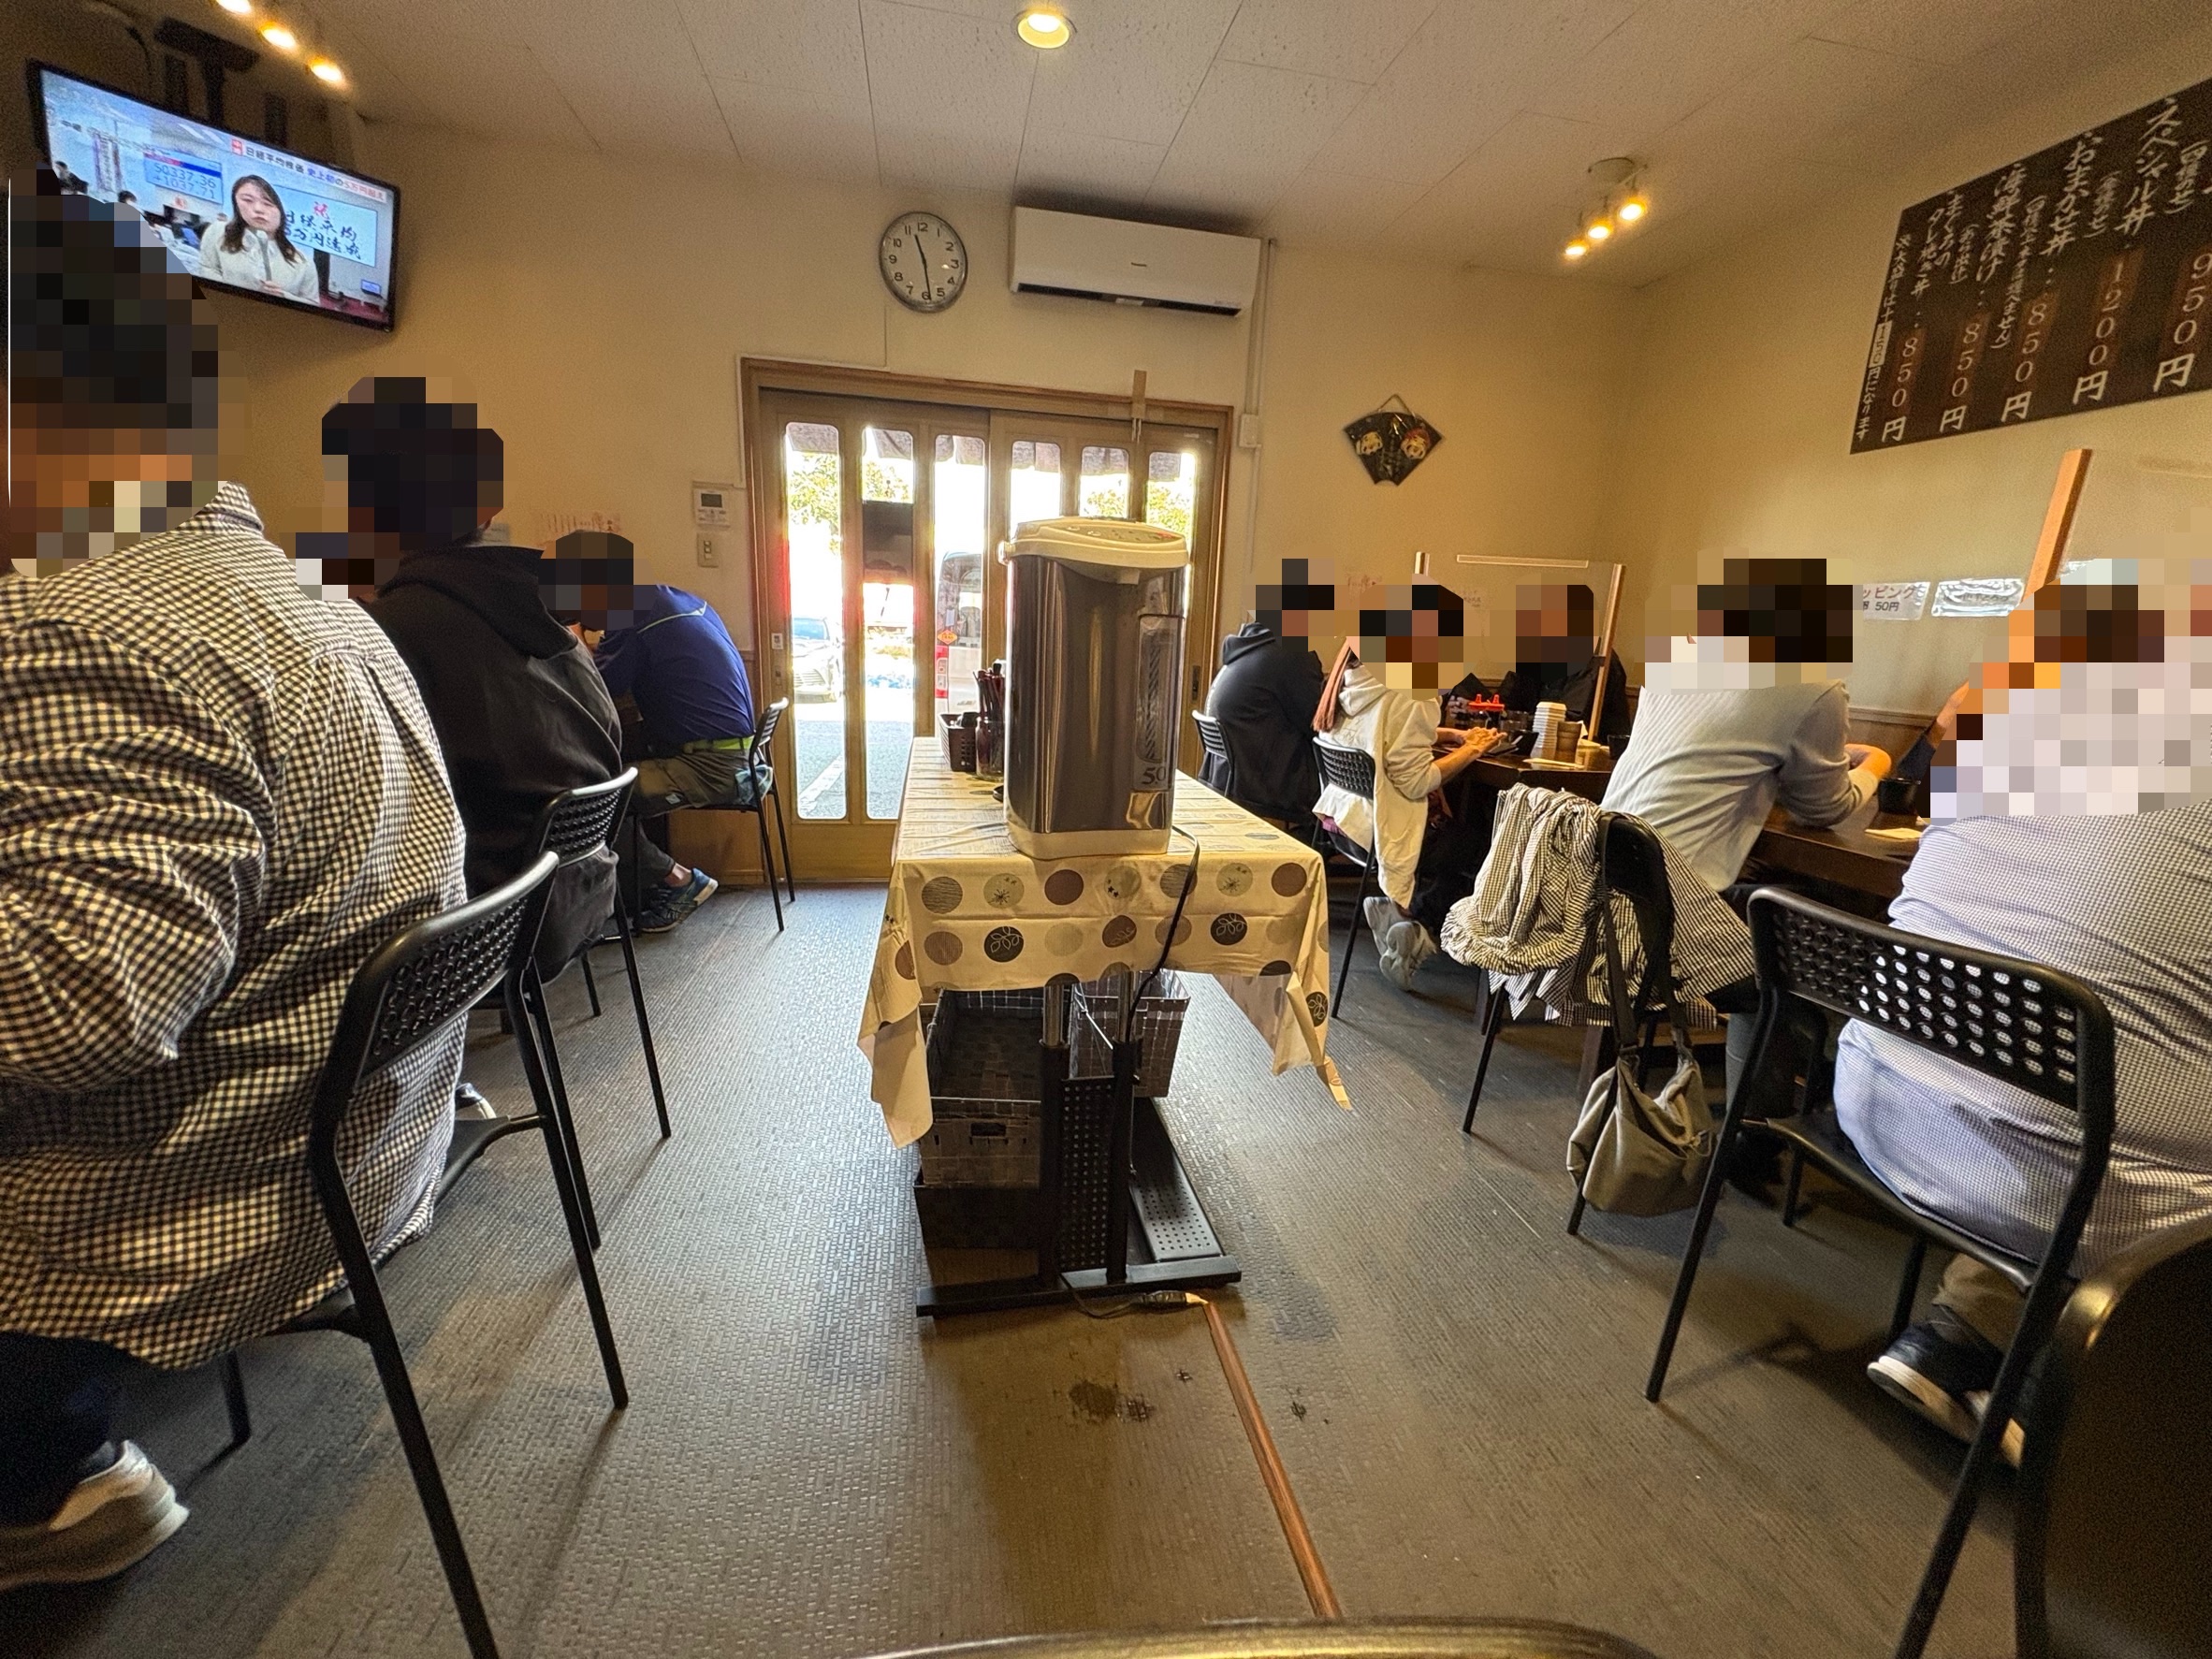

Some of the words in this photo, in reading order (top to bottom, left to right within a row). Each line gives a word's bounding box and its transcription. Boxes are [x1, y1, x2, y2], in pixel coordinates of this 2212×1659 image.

[246, 146, 304, 174] 日経平均株価
[2115, 105, 2182, 237] スペシャル丼
[2039, 138, 2103, 255] おまかせ丼
[917, 222, 928, 232] 12
[1975, 163, 2027, 283] 海鮮茶漬け
[904, 226, 911, 236] 11
[937, 228, 940, 238] 1
[893, 238, 902, 248] 10
[945, 241, 954, 251] 2
[888, 255, 897, 264] 9
[951, 259, 959, 269] 3
[894, 272, 903, 282] 8
[947, 276, 955, 285] 4
[906, 285, 913, 295] 7
[937, 287, 945, 297] 5
[922, 292, 930, 300] 6
[2072, 263, 2125, 405] 1200円
[2001, 302, 2048, 423] 850円
[1940, 322, 1982, 433] 850円
[1881, 337, 1919, 443] 850円
[1875, 602, 1899, 612] 50円
[1142, 765, 1167, 785] 5.0
